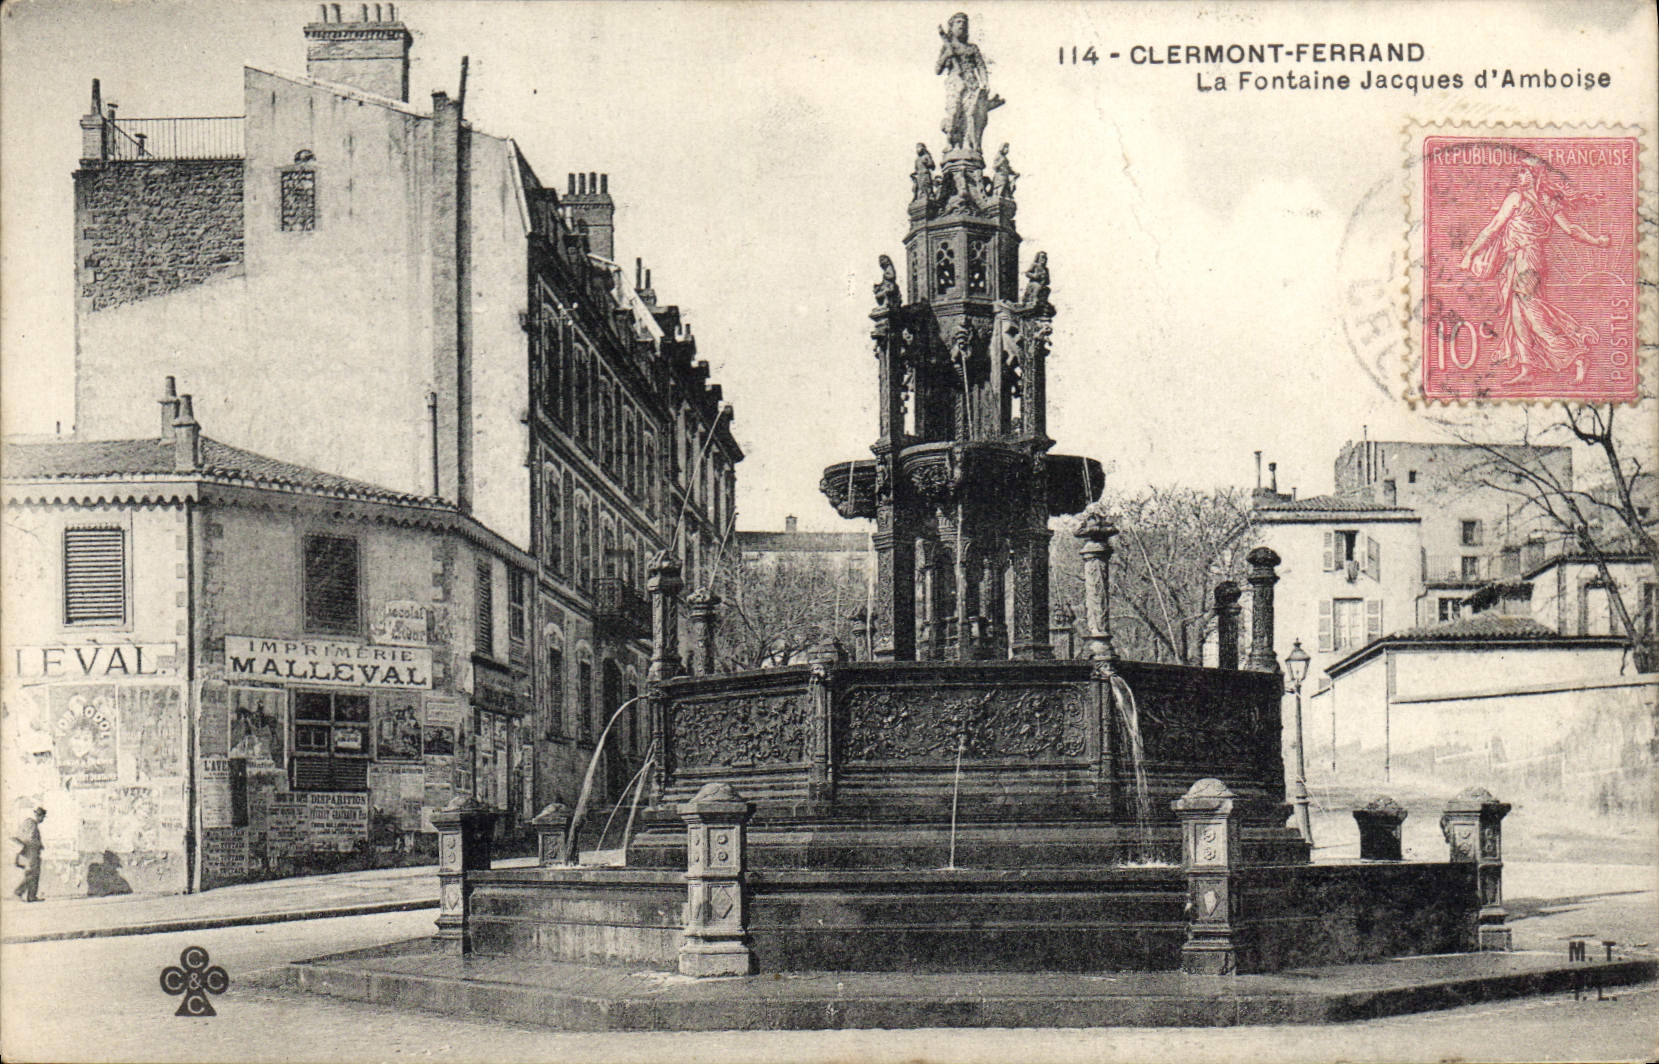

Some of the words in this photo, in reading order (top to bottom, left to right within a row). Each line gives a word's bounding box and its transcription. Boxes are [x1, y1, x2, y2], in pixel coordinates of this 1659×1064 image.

[1609, 297, 1629, 382] POSTES
[249, 640, 414, 662] IMPRIMERIE
[230, 655, 427, 685] MALLEVAL
